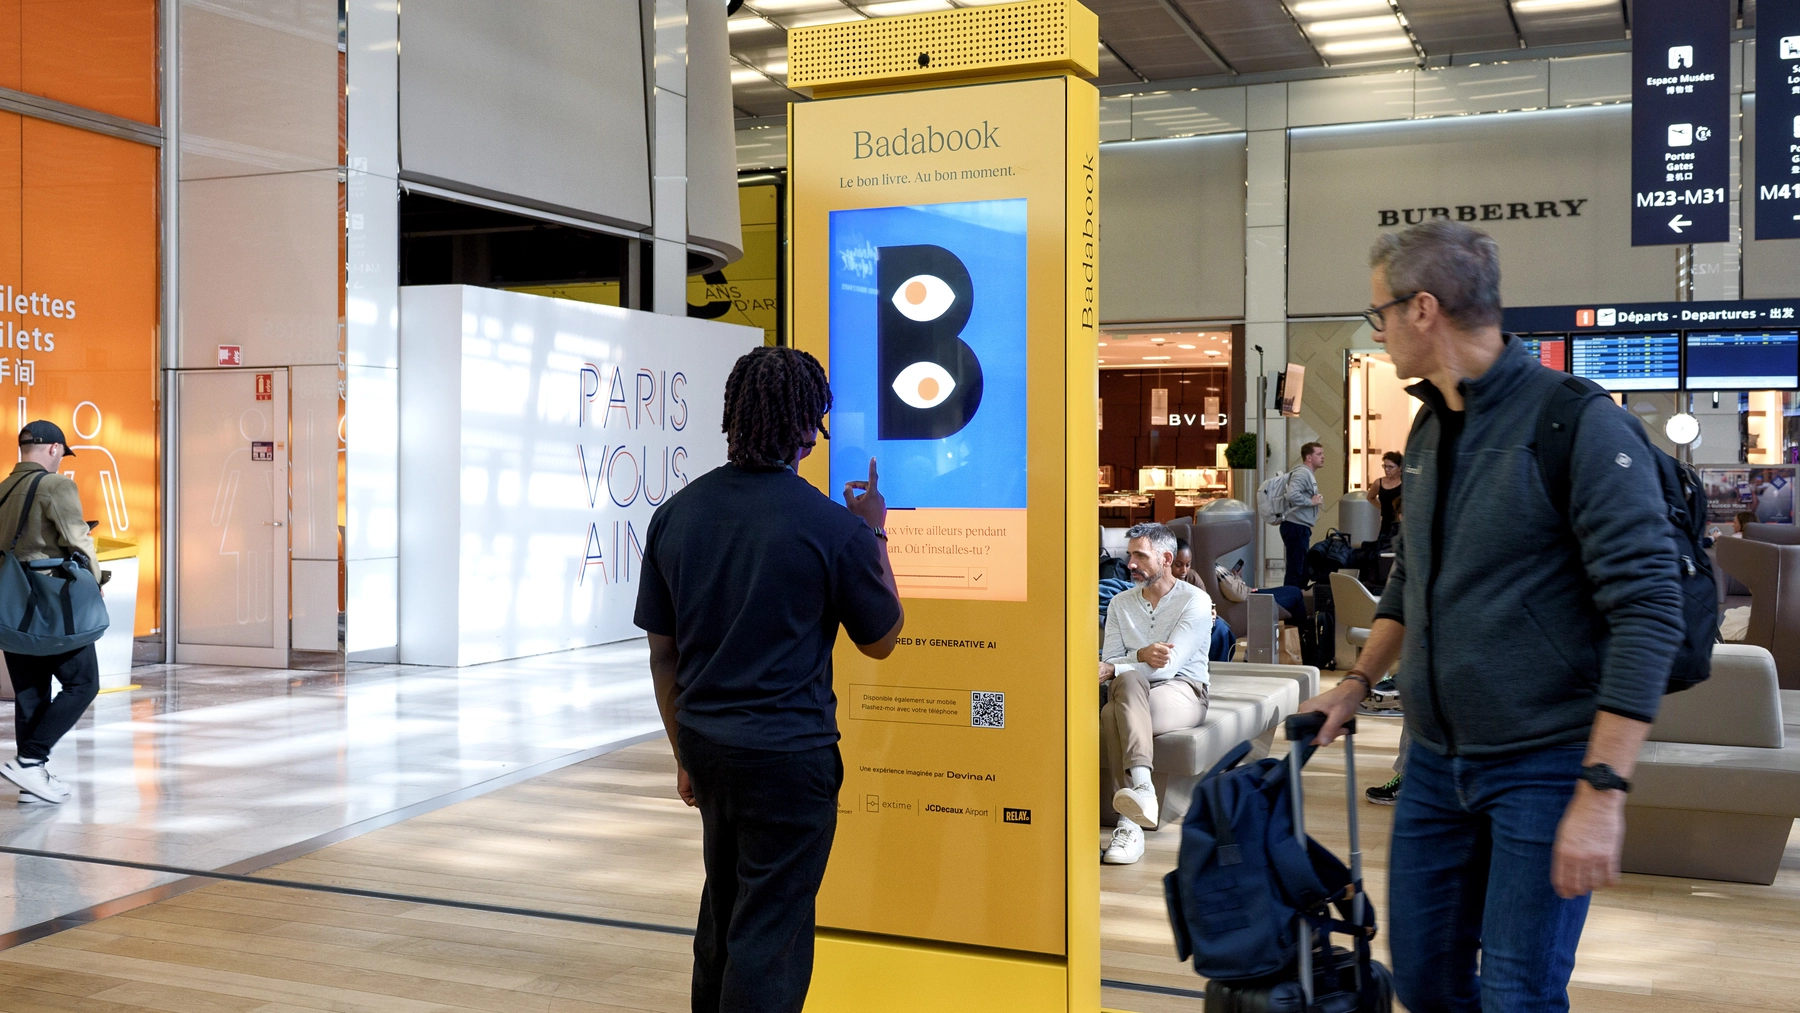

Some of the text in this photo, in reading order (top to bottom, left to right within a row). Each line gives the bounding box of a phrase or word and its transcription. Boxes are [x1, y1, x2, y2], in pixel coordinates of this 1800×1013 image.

[1647, 73, 1715, 86] Espace Musées
[853, 120, 1001, 160] Badabook
[1665, 152, 1695, 161] Portes
[1666, 162, 1694, 171] Gates
[840, 166, 1016, 188] Le bon livre. Au bon moment.
[1636, 188, 1725, 207] M23-M31
[1377, 199, 1588, 226] BURBERRY
[1081, 151, 1094, 332] Badabook
[706, 286, 741, 299] ANS
[734, 298, 777, 312] D'AR
[1618, 311, 1669, 323] Départs
[1681, 308, 1756, 322] Departures
[1770, 307, 1794, 319] 出发
[579, 363, 688, 431] PARIS
[577, 444, 689, 508] VOUS
[900, 525, 924, 535] vivre
[926, 525, 963, 536] ailleurs
[965, 526, 1007, 538] pendant
[905, 543, 919, 554] Où
[915, 638, 927, 646] BY
[929, 638, 985, 649] GENERATIVE
[987, 641, 997, 649] AI
[863, 694, 893, 703] Disponible
[894, 695, 925, 705] également
[937, 698, 957, 706] mobile
[861, 704, 896, 712] Flashez-moi
[928, 708, 958, 716] téléphone
[872, 766, 905, 775] expérience
[905, 768, 933, 777] imaginée
[946, 770, 983, 781] Devina
[882, 801, 912, 810] extime
[925, 804, 989, 817] JCDecaux Airport
